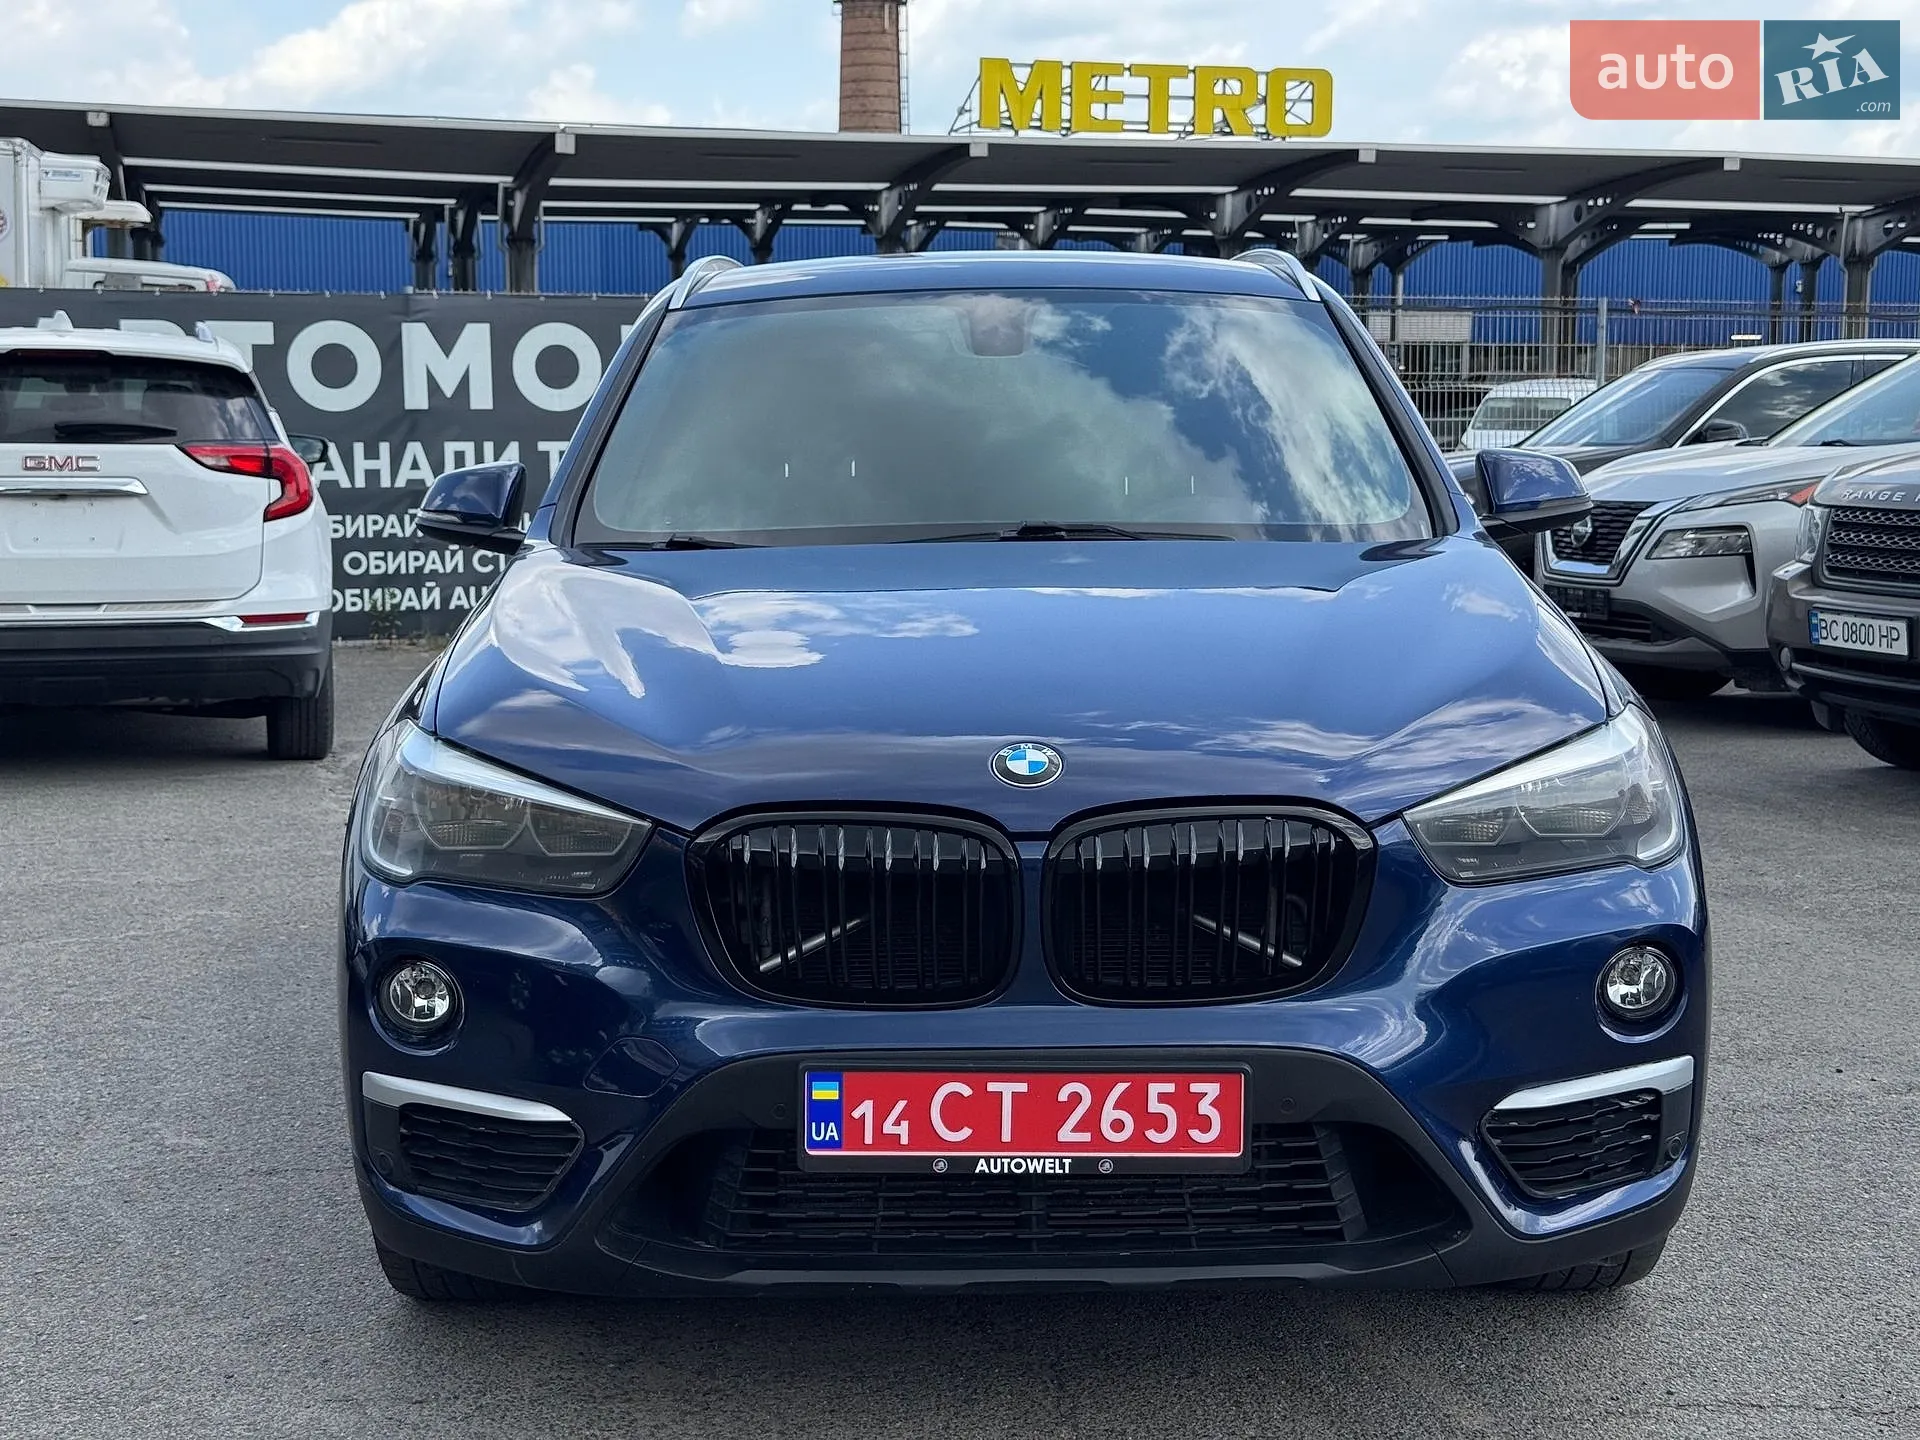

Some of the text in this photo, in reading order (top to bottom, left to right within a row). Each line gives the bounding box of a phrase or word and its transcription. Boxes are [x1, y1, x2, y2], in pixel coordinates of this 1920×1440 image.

[979, 57, 1333, 138] METRO
[38, 315, 634, 413] ТОМО
[23, 455, 101, 473] GMC
[1842, 488, 1906, 502] RANGE
[328, 508, 424, 539] БИРАЙ
[343, 544, 464, 576] ОБИРАЙ
[1820, 618, 1838, 641] BC
[1842, 621, 1875, 646] 0800
[1878, 624, 1900, 649] HP
[1000, 743, 1056, 756] BMW
[811, 1082, 1221, 1145] UA 14 CT 2653
[975, 1158, 1072, 1174] AUTOWELT
